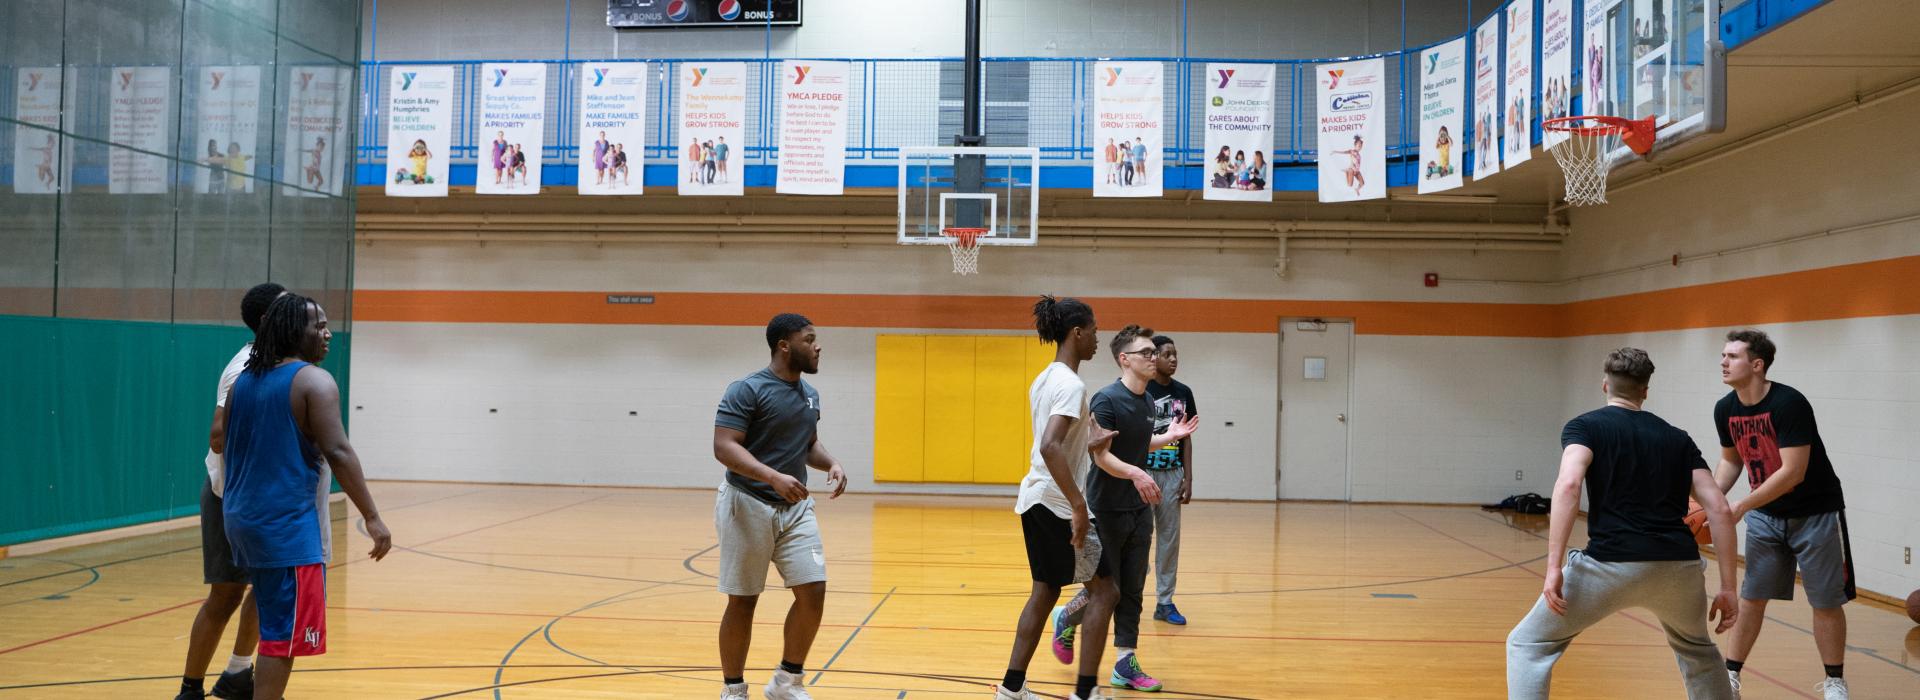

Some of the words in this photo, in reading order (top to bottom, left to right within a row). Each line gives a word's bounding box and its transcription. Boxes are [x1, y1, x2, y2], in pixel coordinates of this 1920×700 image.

[744, 11, 775, 20] BONUS
[787, 92, 810, 100] YMCA
[812, 93, 844, 101] PLEDGE
[424, 98, 439, 106] Amy
[393, 106, 430, 114] Humphries
[1321, 115, 1347, 124] MAKES
[1348, 113, 1367, 122] KIDS
[1224, 124, 1271, 132] COMMUNITY
[1328, 123, 1364, 132] PRIORITY
[304, 625, 320, 648] KU
